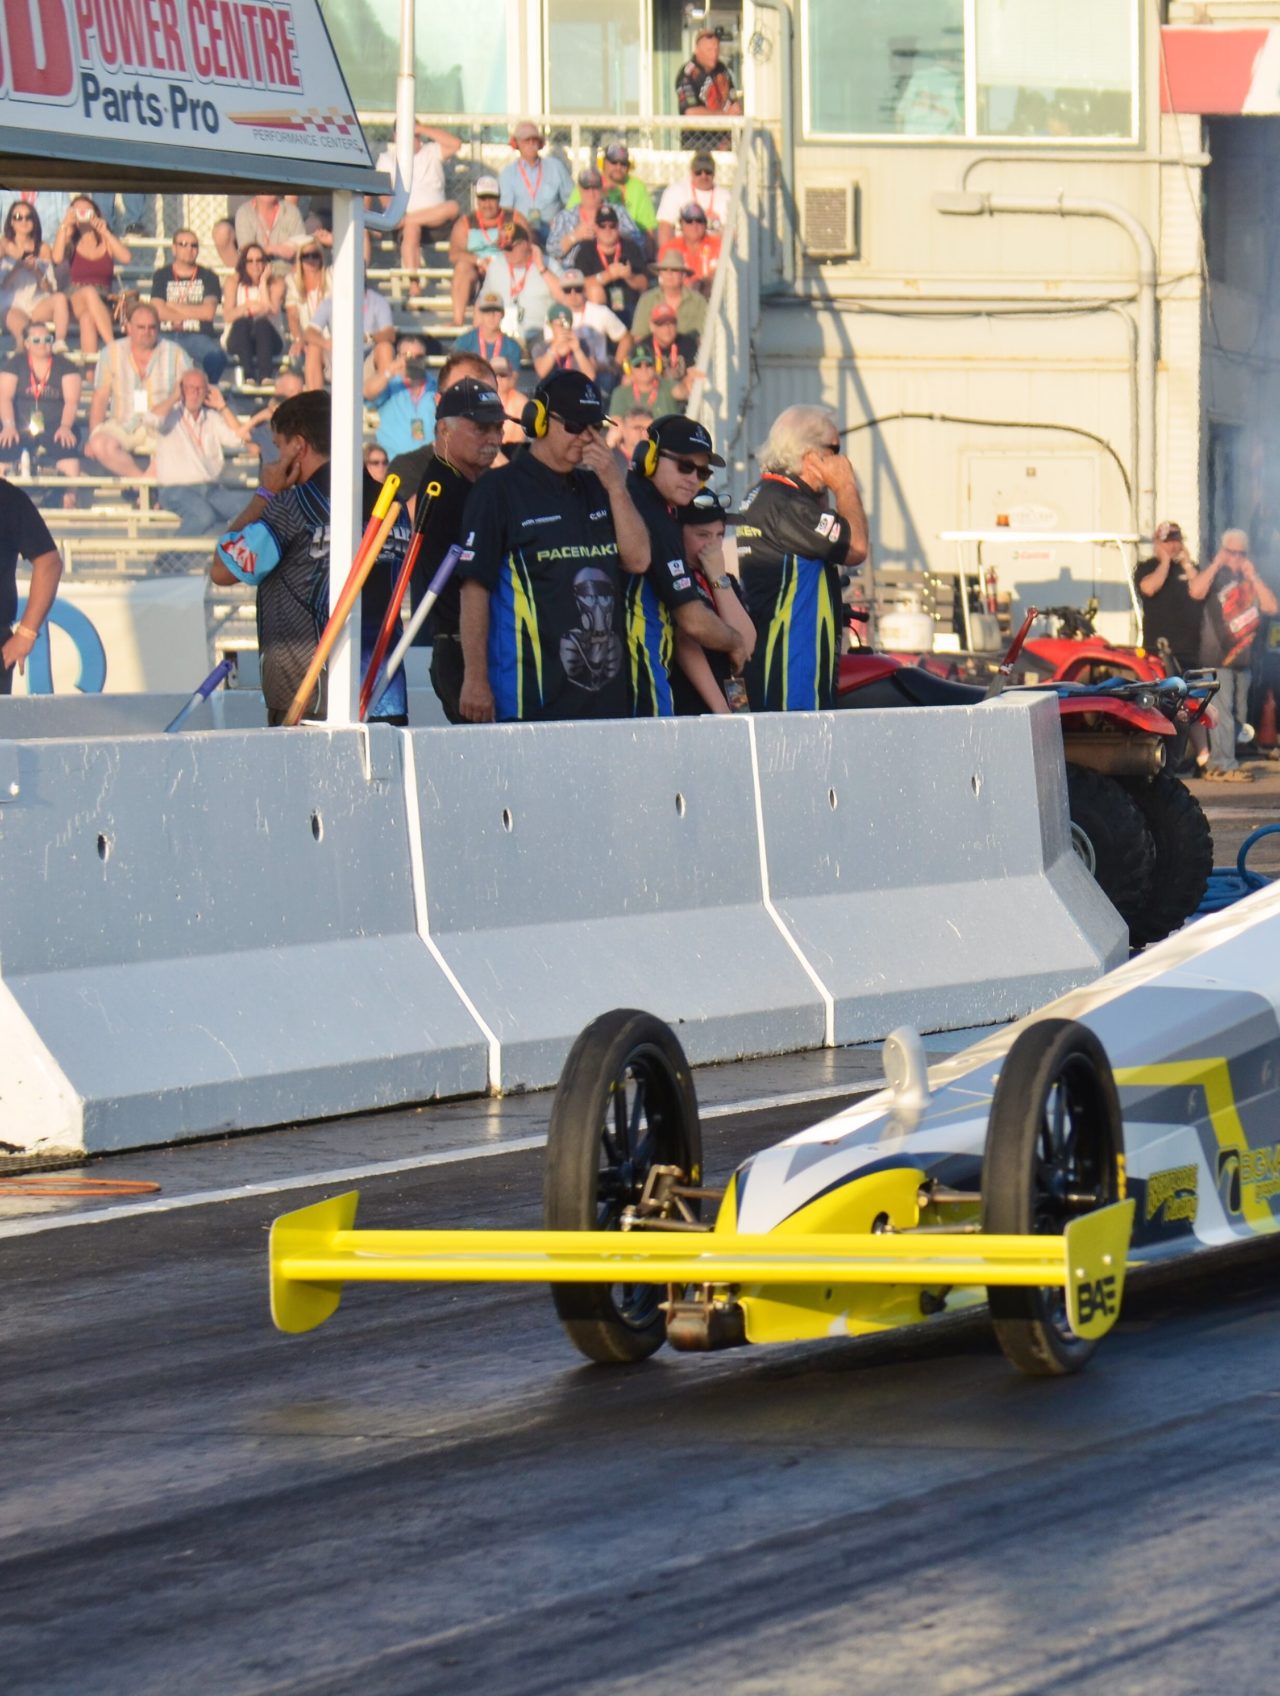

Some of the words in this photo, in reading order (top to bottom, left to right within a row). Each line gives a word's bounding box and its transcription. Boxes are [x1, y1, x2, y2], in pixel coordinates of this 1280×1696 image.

[76, 0, 187, 73] POWER
[187, 0, 300, 87] CENTRE
[81, 72, 163, 127] Parts
[168, 84, 220, 134] Pro
[252, 128, 319, 147] PERFORMANCE
[1077, 1275, 1115, 1325] BAE
